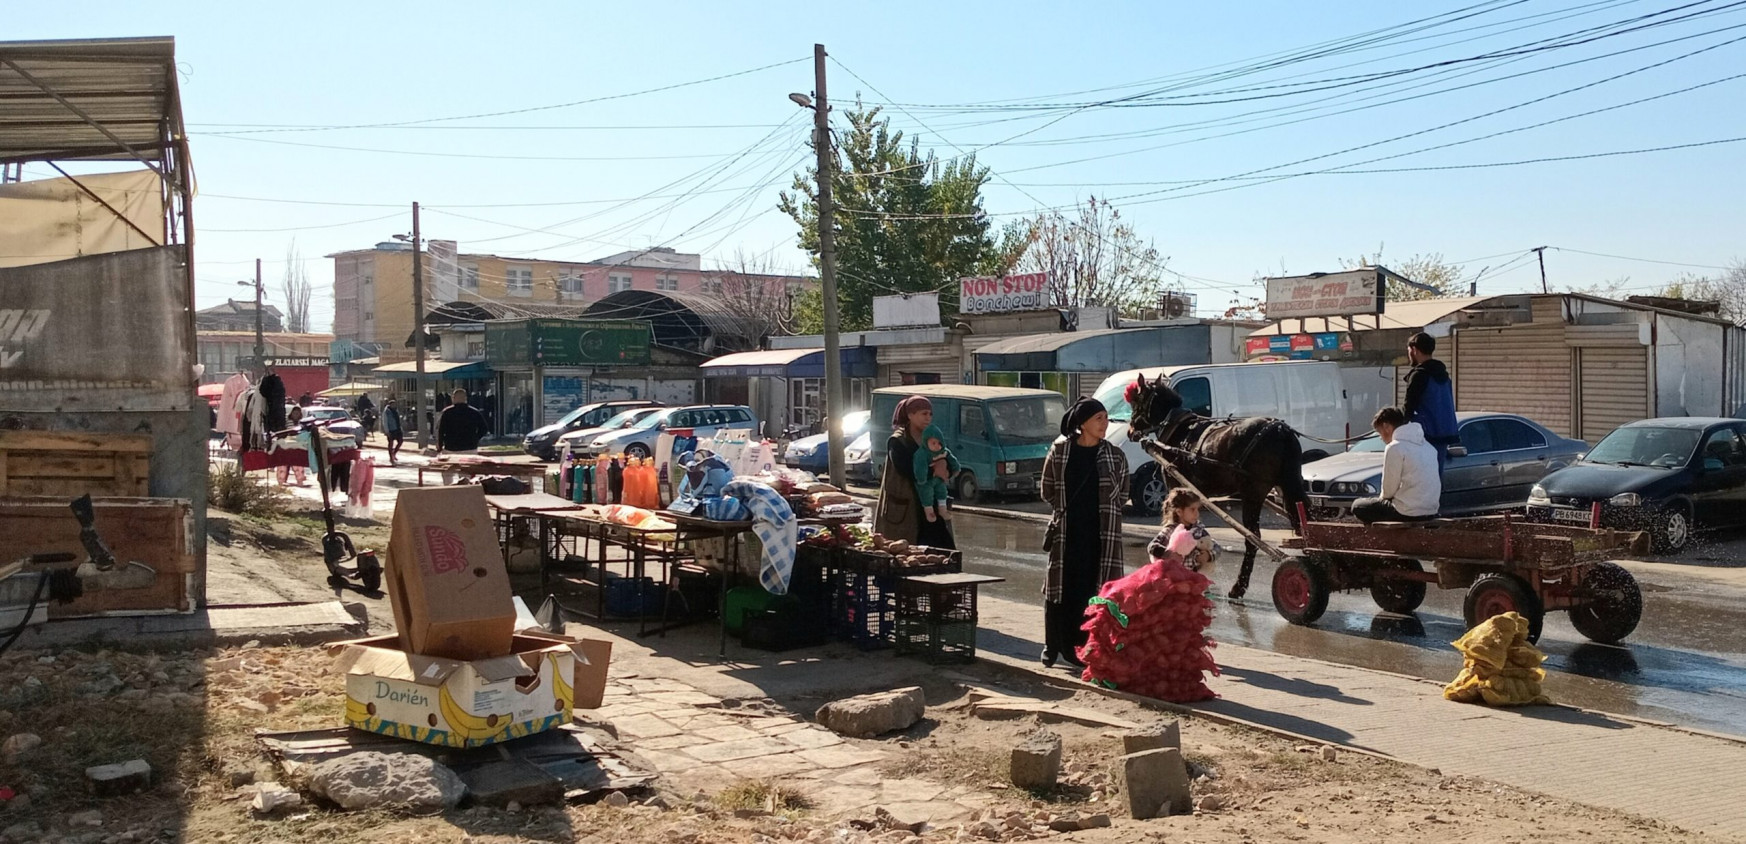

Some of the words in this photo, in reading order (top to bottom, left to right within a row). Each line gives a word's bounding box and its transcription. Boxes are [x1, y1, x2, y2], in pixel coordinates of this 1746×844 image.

[963, 279, 998, 297] NON
[1003, 273, 1047, 294] STOP
[967, 292, 1041, 312] Bonchewi
[375, 680, 428, 707] Darién
